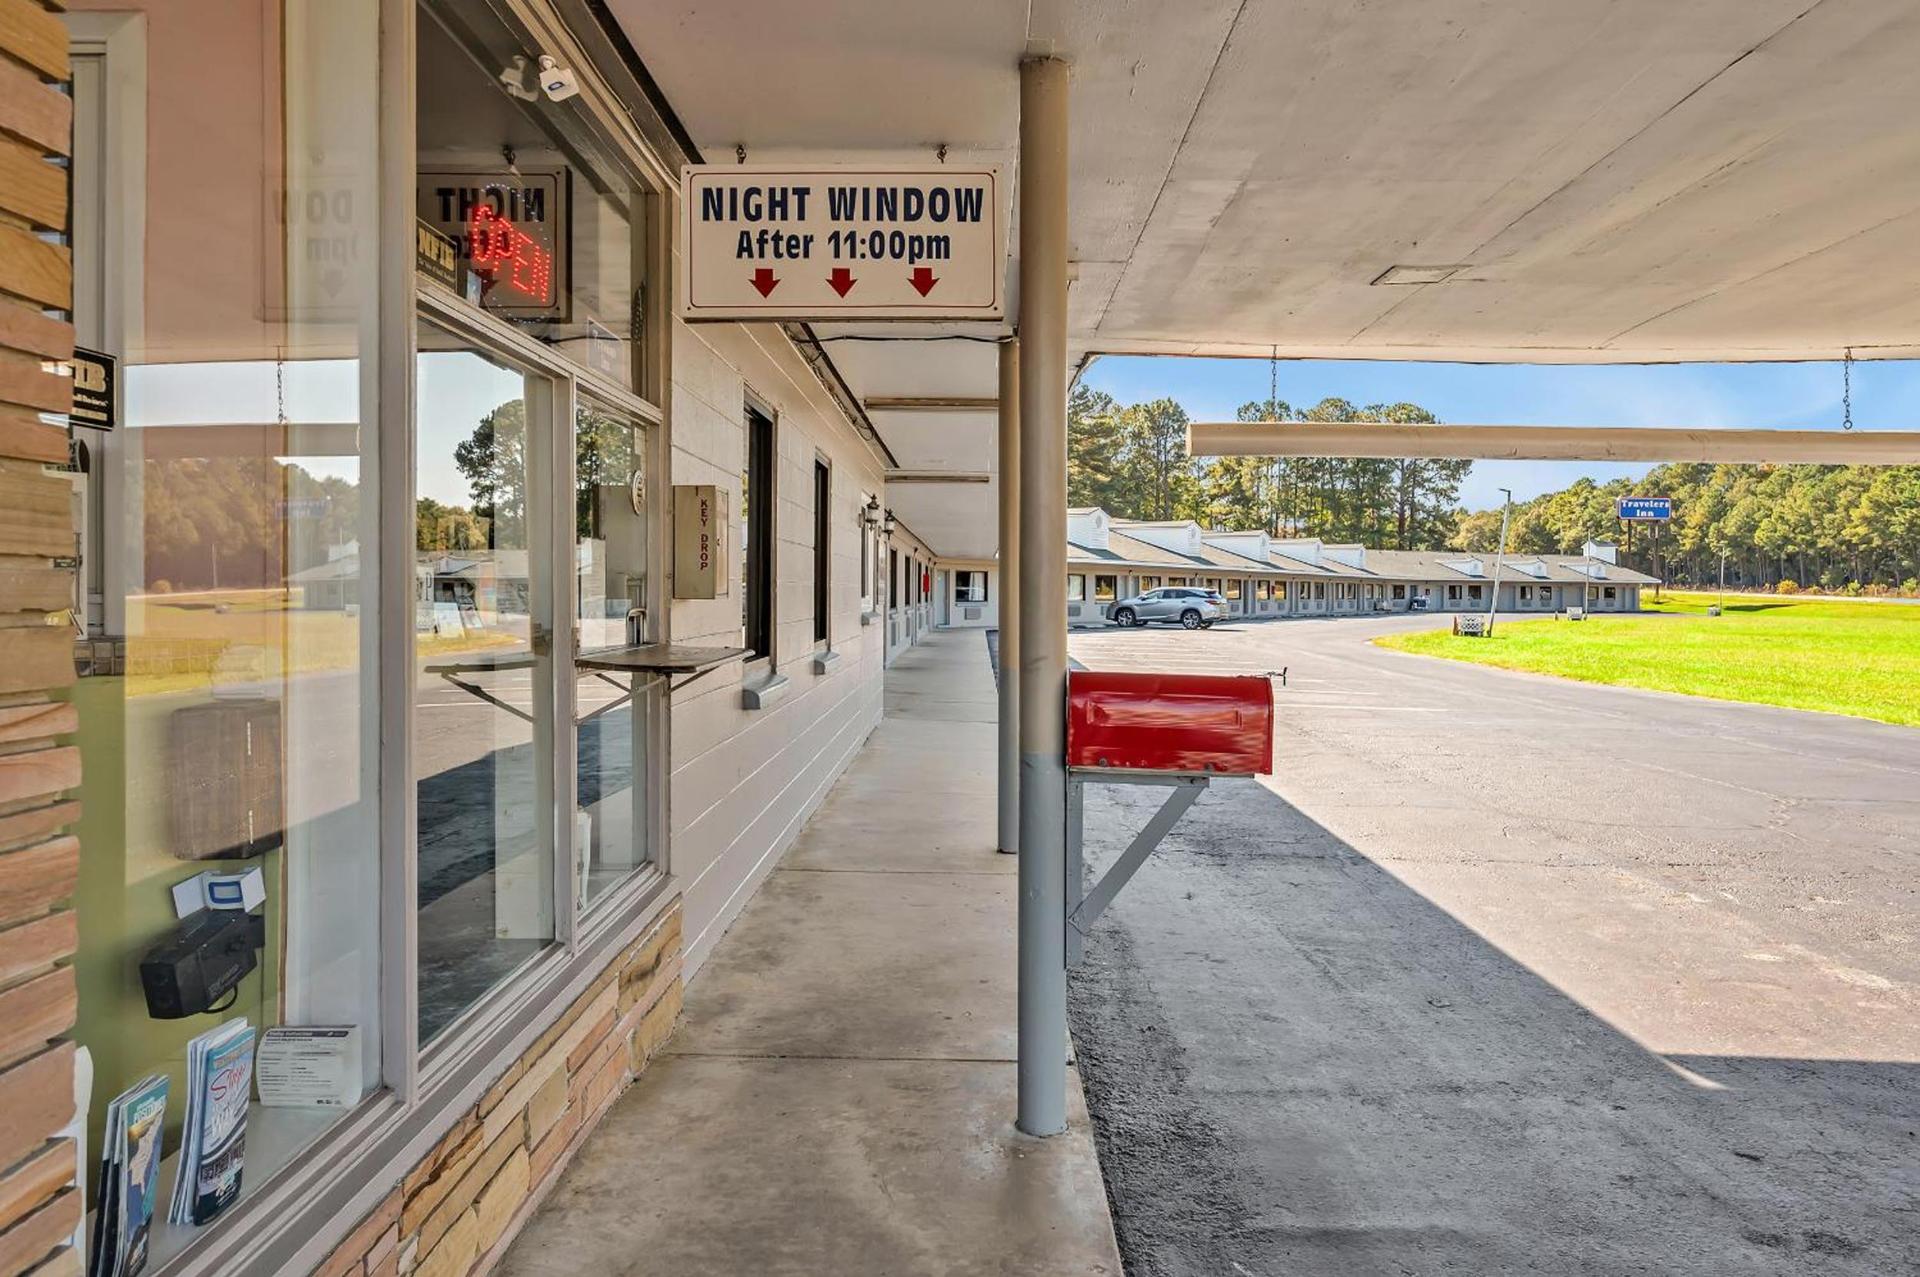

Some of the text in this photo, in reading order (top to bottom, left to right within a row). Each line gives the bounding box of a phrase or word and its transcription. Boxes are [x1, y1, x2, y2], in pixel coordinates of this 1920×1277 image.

[701, 186, 985, 223] NIGHT WINDOW
[472, 204, 551, 303] OPEN
[736, 229, 951, 265] After 11:00pm
[1621, 500, 1669, 508] Travelers
[1636, 509, 1654, 517] Inn
[700, 499, 709, 570] KEY DROP
